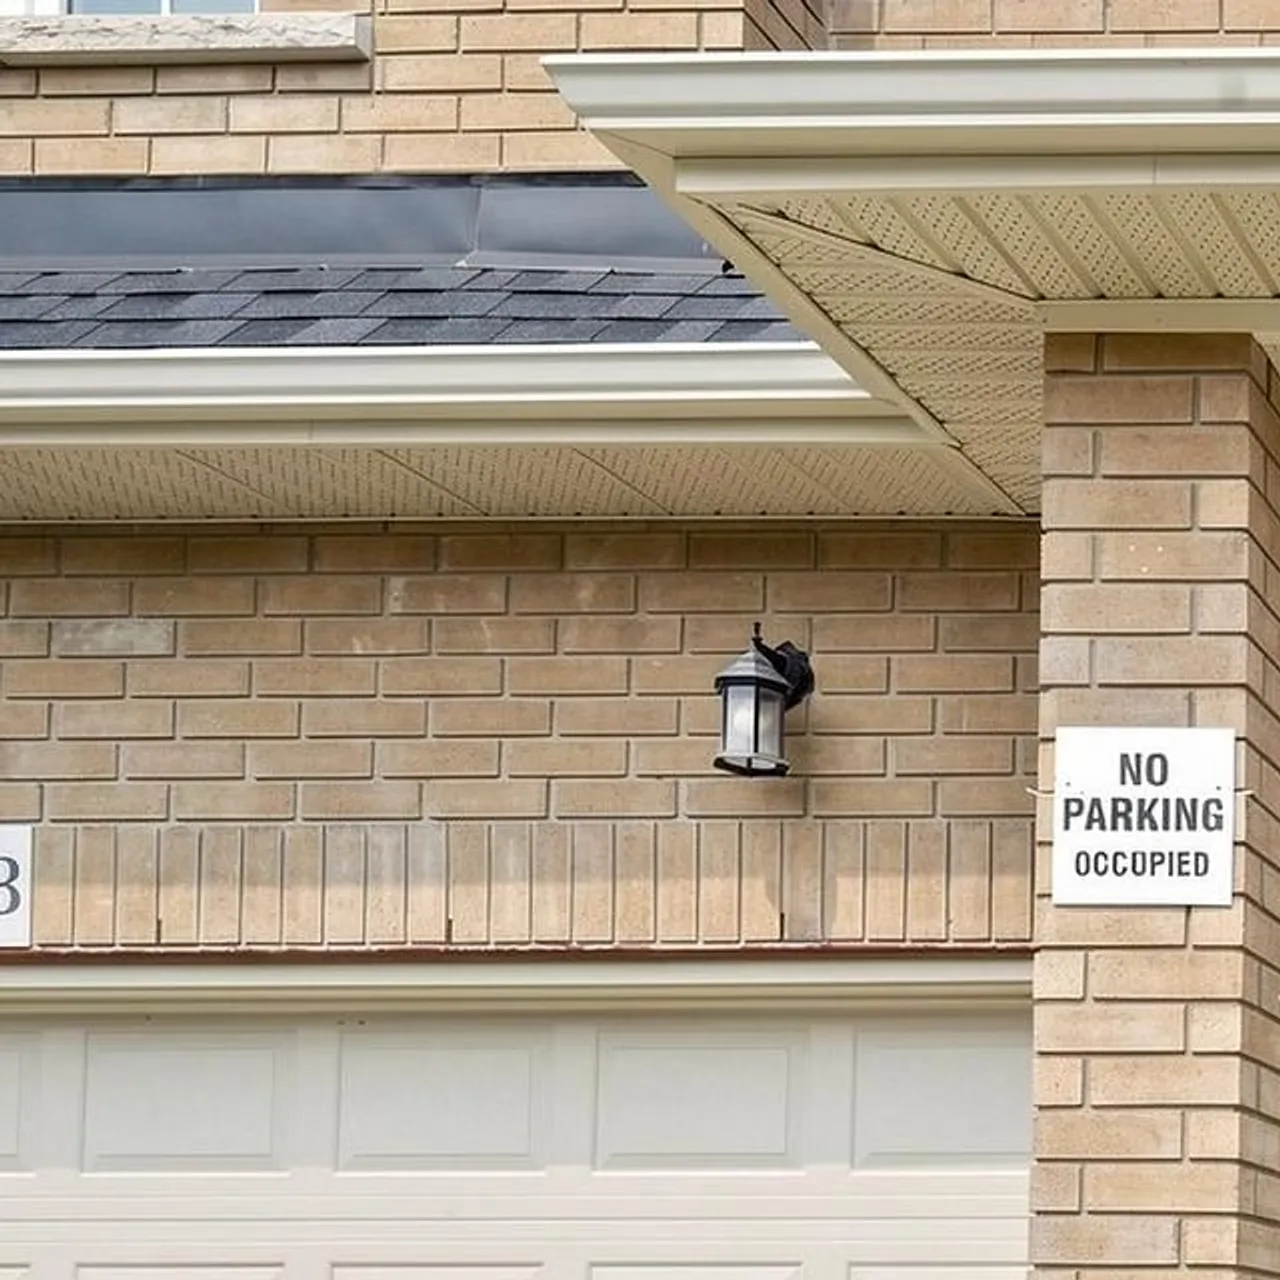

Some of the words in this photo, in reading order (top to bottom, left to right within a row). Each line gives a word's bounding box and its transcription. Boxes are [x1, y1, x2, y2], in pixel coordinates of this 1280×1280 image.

[1119, 752, 1169, 787] NO
[1063, 797, 1224, 832] PARKING
[1074, 850, 1210, 877] OCCUPIED
